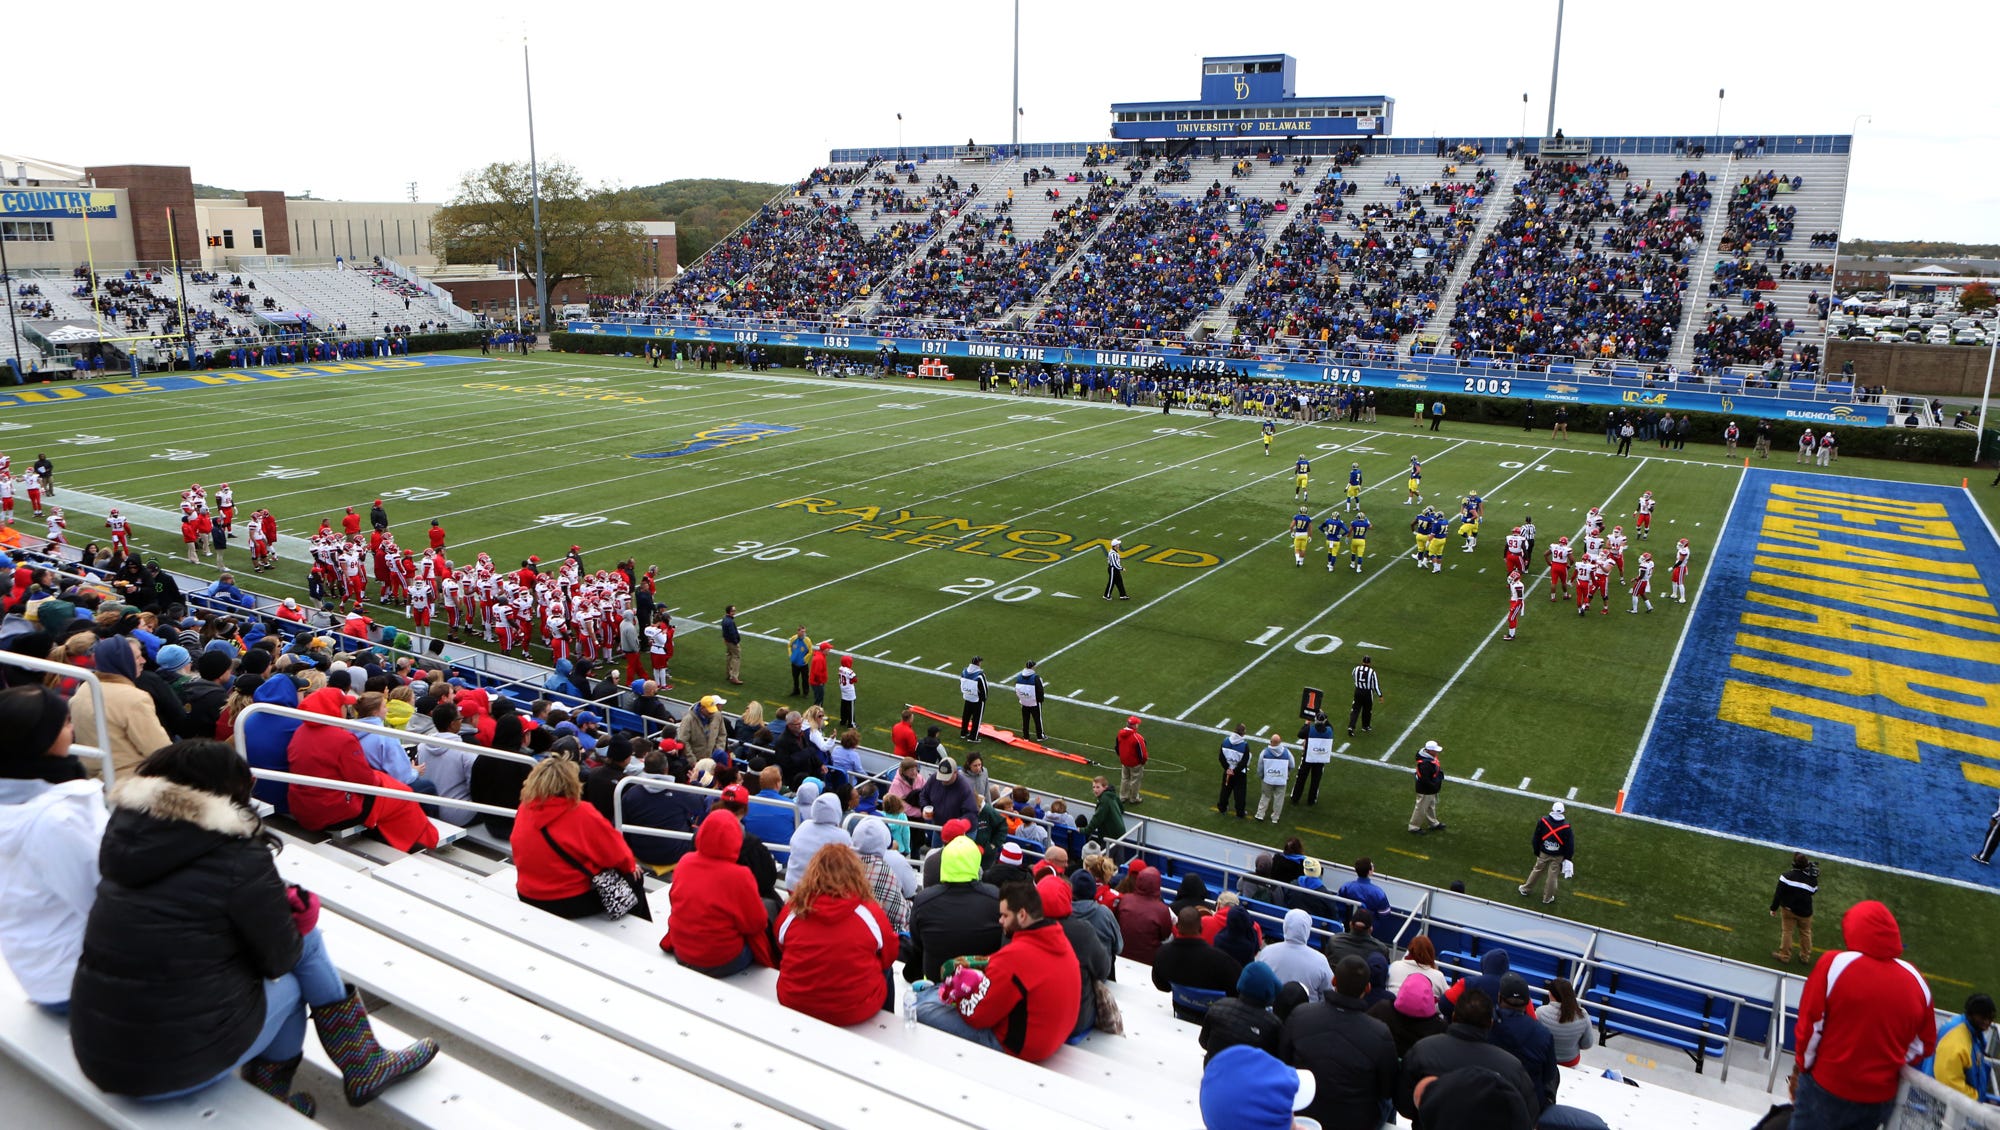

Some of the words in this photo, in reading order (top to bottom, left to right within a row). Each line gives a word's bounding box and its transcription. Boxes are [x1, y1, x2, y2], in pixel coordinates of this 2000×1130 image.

[1234, 76, 1250, 100] UD
[1176, 122, 1235, 133] UNIVERSITY
[1240, 122, 1254, 131] OF
[1259, 121, 1312, 131] DELAWARE
[2, 191, 92, 212] COUNTRY
[68, 205, 111, 214] WECOME
[46, 331, 113, 342] adidas
[734, 331, 758, 343] 1946
[823, 336, 850, 348] 1963
[921, 341, 947, 353] 1971
[968, 344, 1001, 357] HOME
[1004, 347, 1019, 358] OF
[1022, 348, 1045, 361] THE
[1096, 352, 1128, 366] BLUE
[1131, 354, 1165, 367] HENS
[1191, 358, 1226, 373] 1972
[182, 359, 427, 385] HENS
[1322, 367, 1361, 383] 1979
[1464, 377, 1512, 394] 2003
[1315, 443, 1376, 454] 20
[1497, 460, 1554, 472] 10
[379, 486, 452, 502] 50
[113, 522, 123, 530] 13
[533, 511, 609, 529] 40
[770, 496, 1224, 569] RAYMOND
[712, 540, 801, 561] 30
[832, 521, 1068, 564] FIELD
[1508, 539, 1519, 549] 93
[1589, 541, 1596, 550] 6
[938, 577, 1042, 603] 20
[1244, 625, 1343, 655] 10
[1717, 483, 2000, 789] DELAWARE
[1358, 671, 1366, 682] L
[1306, 691, 1316, 710] 1
